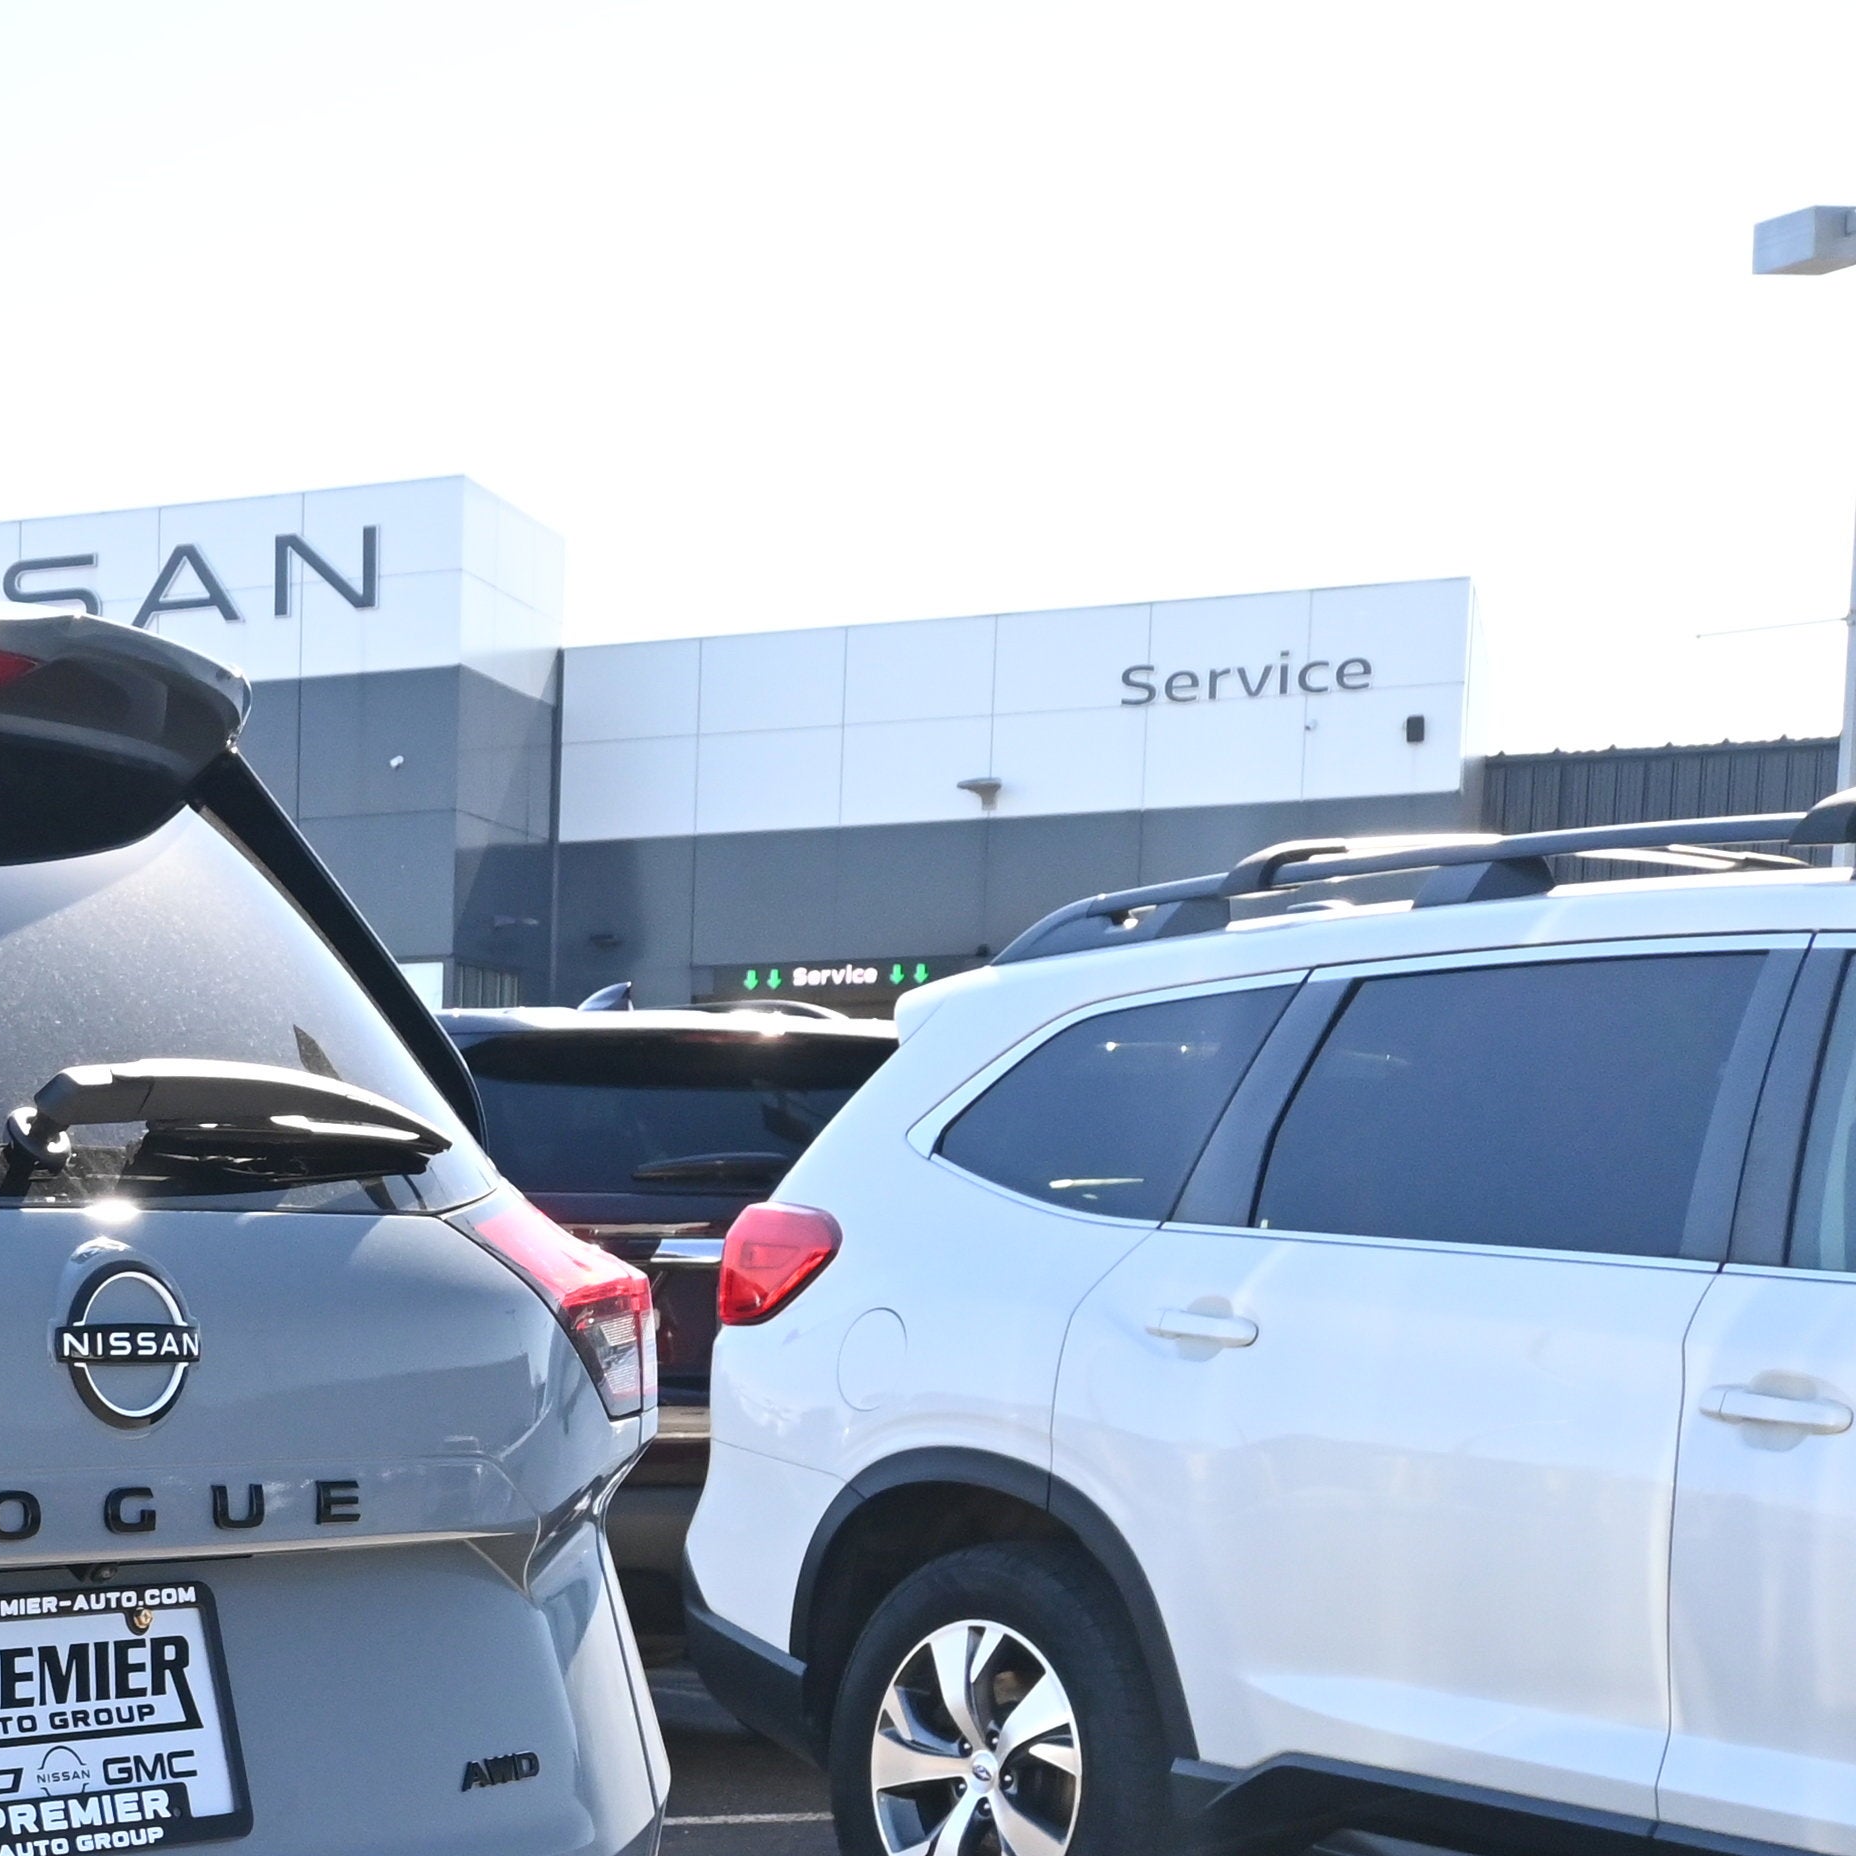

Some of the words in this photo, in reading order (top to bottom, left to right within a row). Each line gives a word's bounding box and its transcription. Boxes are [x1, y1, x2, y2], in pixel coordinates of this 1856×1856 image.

[1121, 650, 1372, 705] Service
[792, 963, 879, 987] Service
[62, 1332, 199, 1357] NISSAN
[48, 1703, 156, 1729] GROUP
[36, 1769, 91, 1784] NISSAN
[102, 1750, 198, 1785] GMC
[461, 1750, 540, 1792] AWD
[76, 1826, 164, 1851] GROUP
